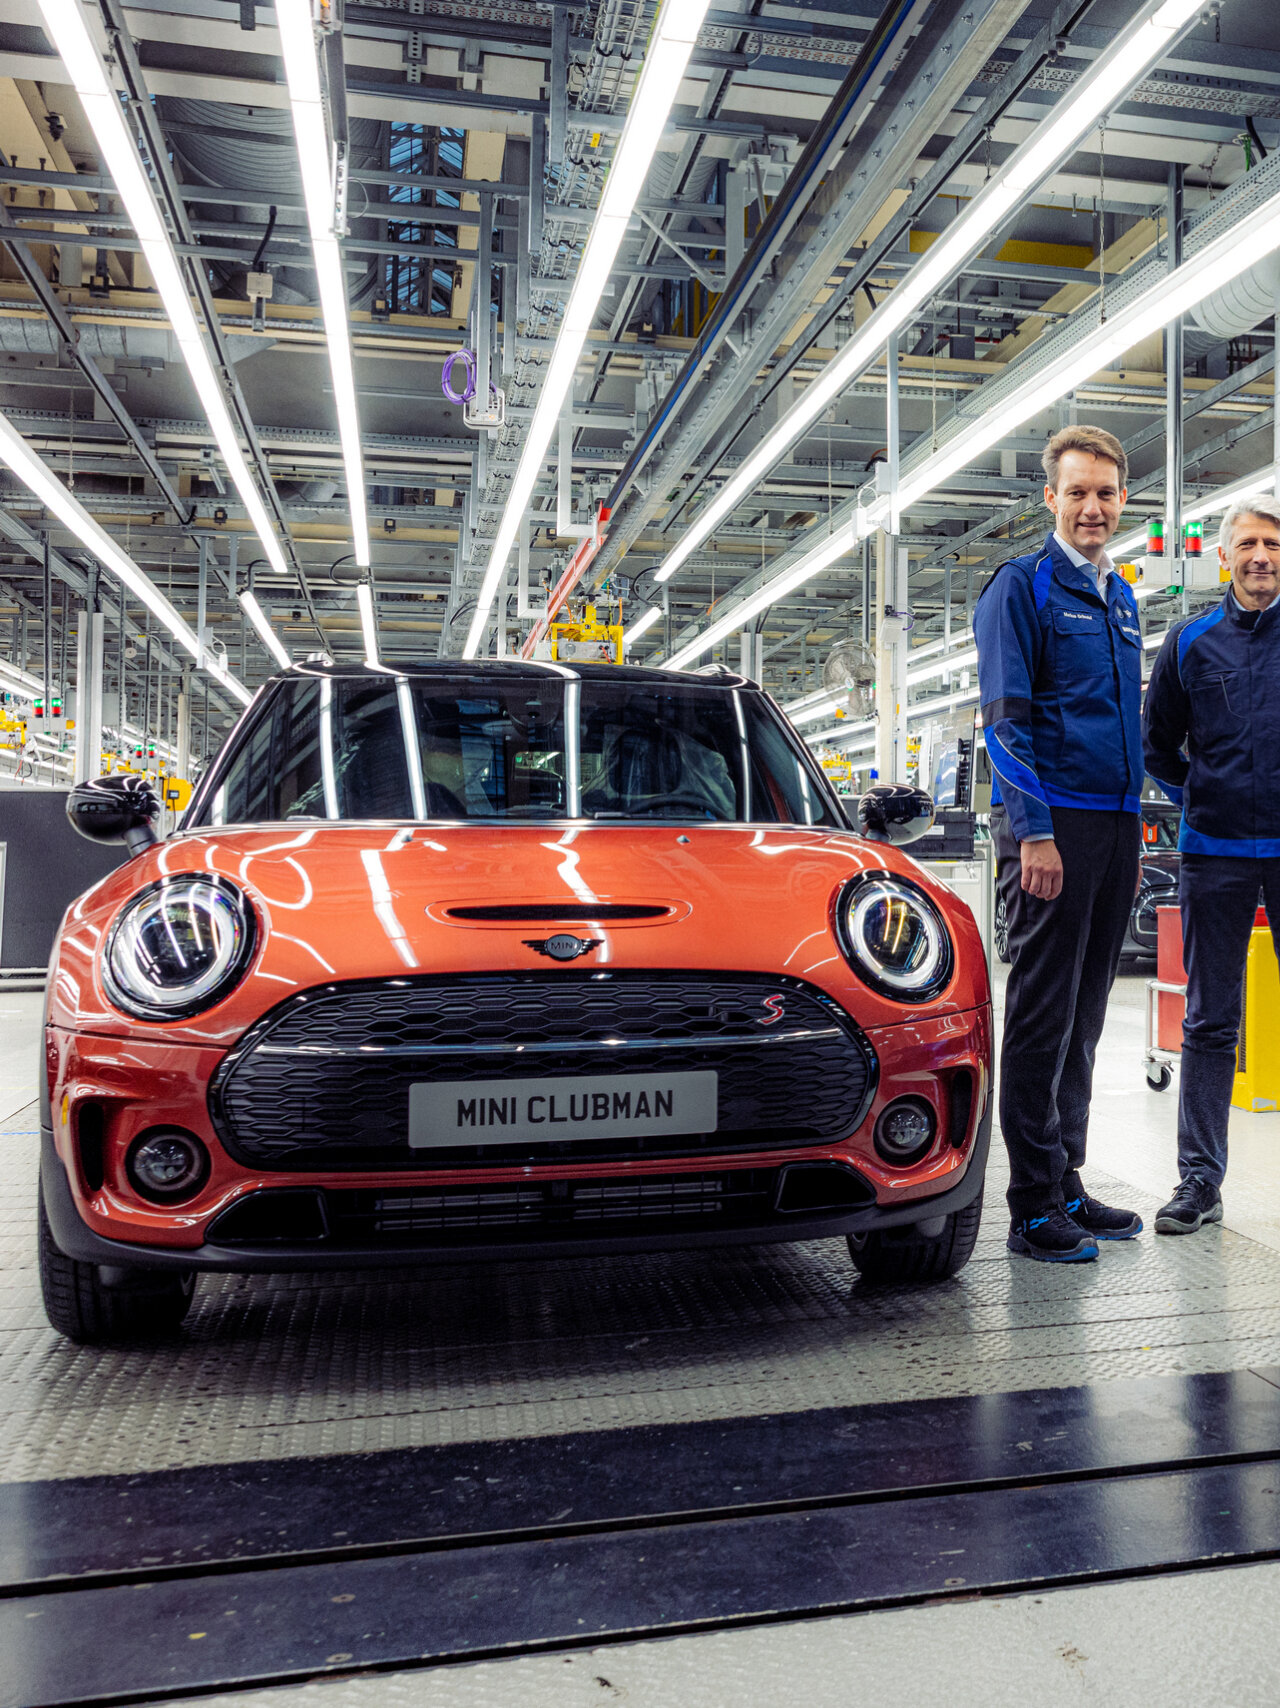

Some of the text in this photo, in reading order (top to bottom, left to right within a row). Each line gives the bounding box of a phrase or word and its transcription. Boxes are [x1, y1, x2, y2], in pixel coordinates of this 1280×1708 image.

[757, 993, 785, 1025] S
[457, 1089, 673, 1127] MINI CLUBMAN
